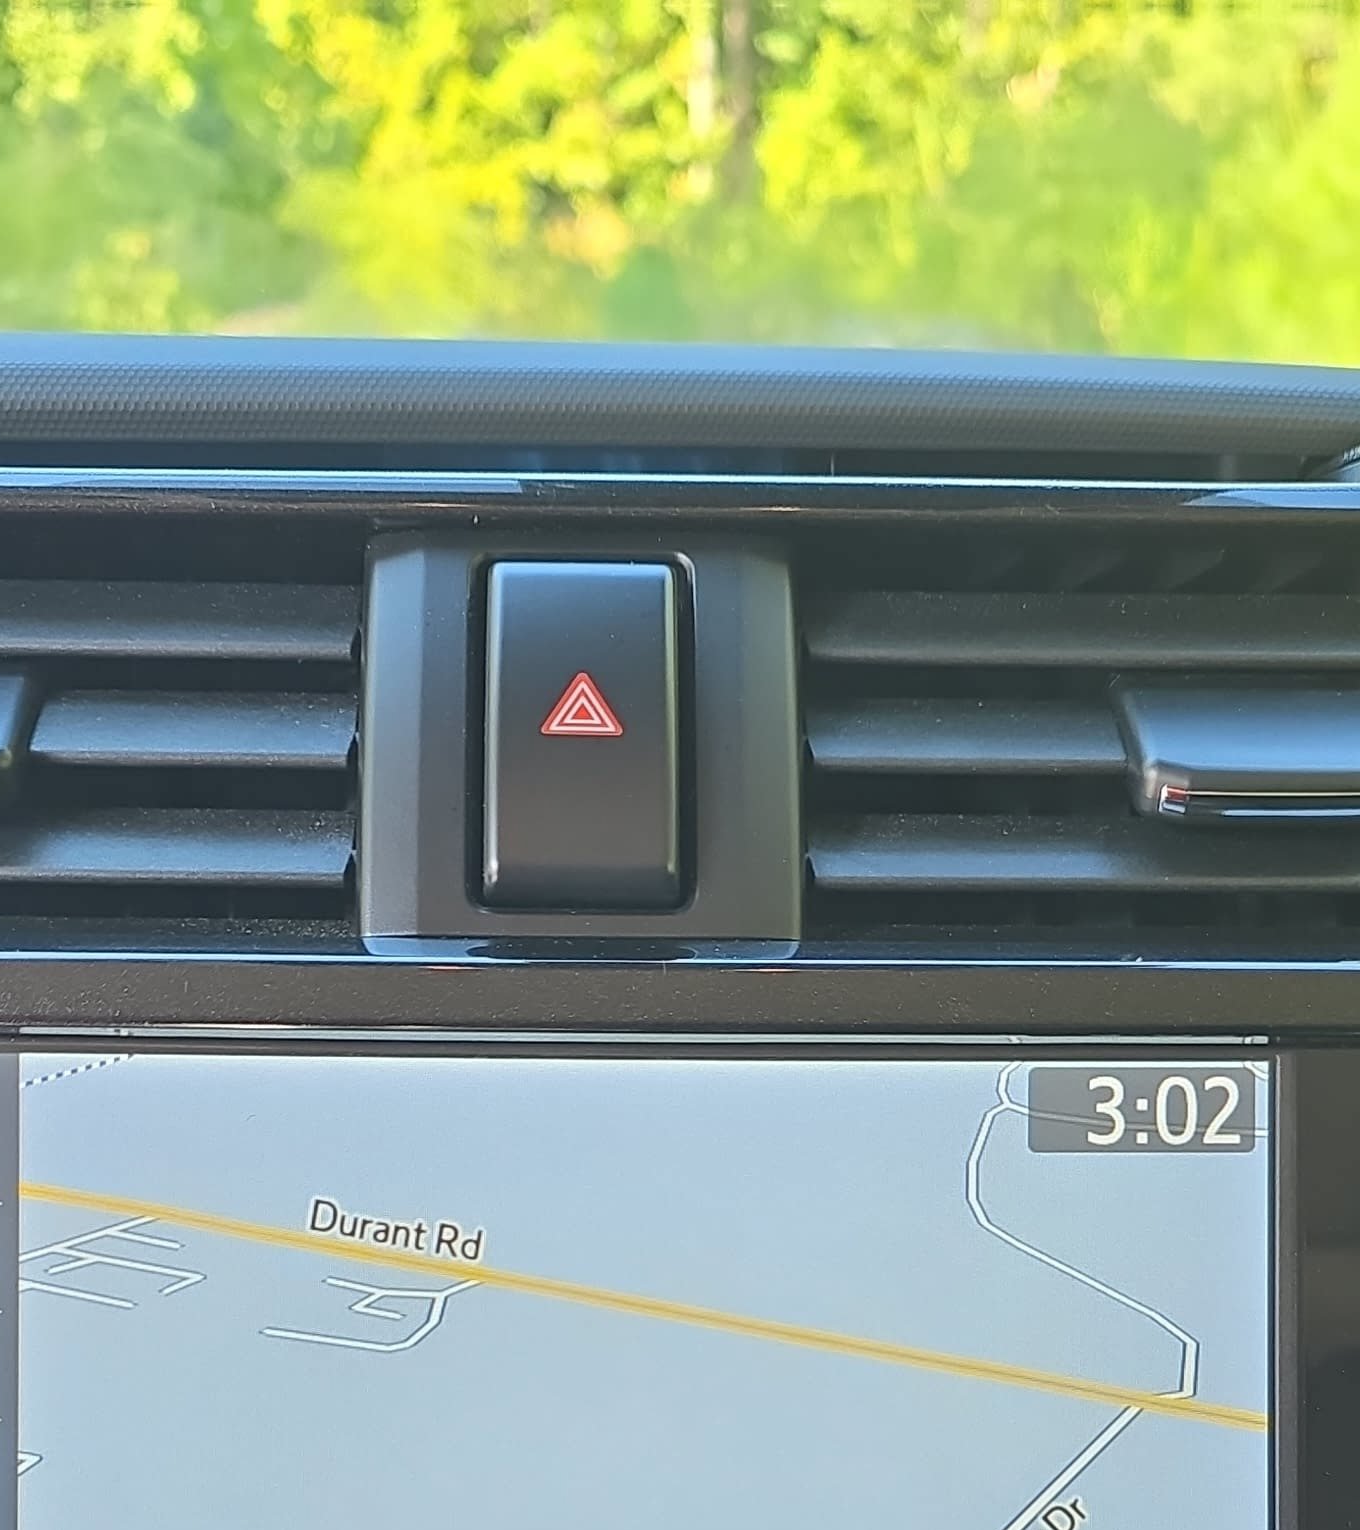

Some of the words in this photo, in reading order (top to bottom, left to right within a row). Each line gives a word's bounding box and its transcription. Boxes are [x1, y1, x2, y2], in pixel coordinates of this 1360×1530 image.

[1086, 1075, 1242, 1146] 3:02
[310, 1199, 427, 1250] Durant
[434, 1222, 484, 1261] Rd
